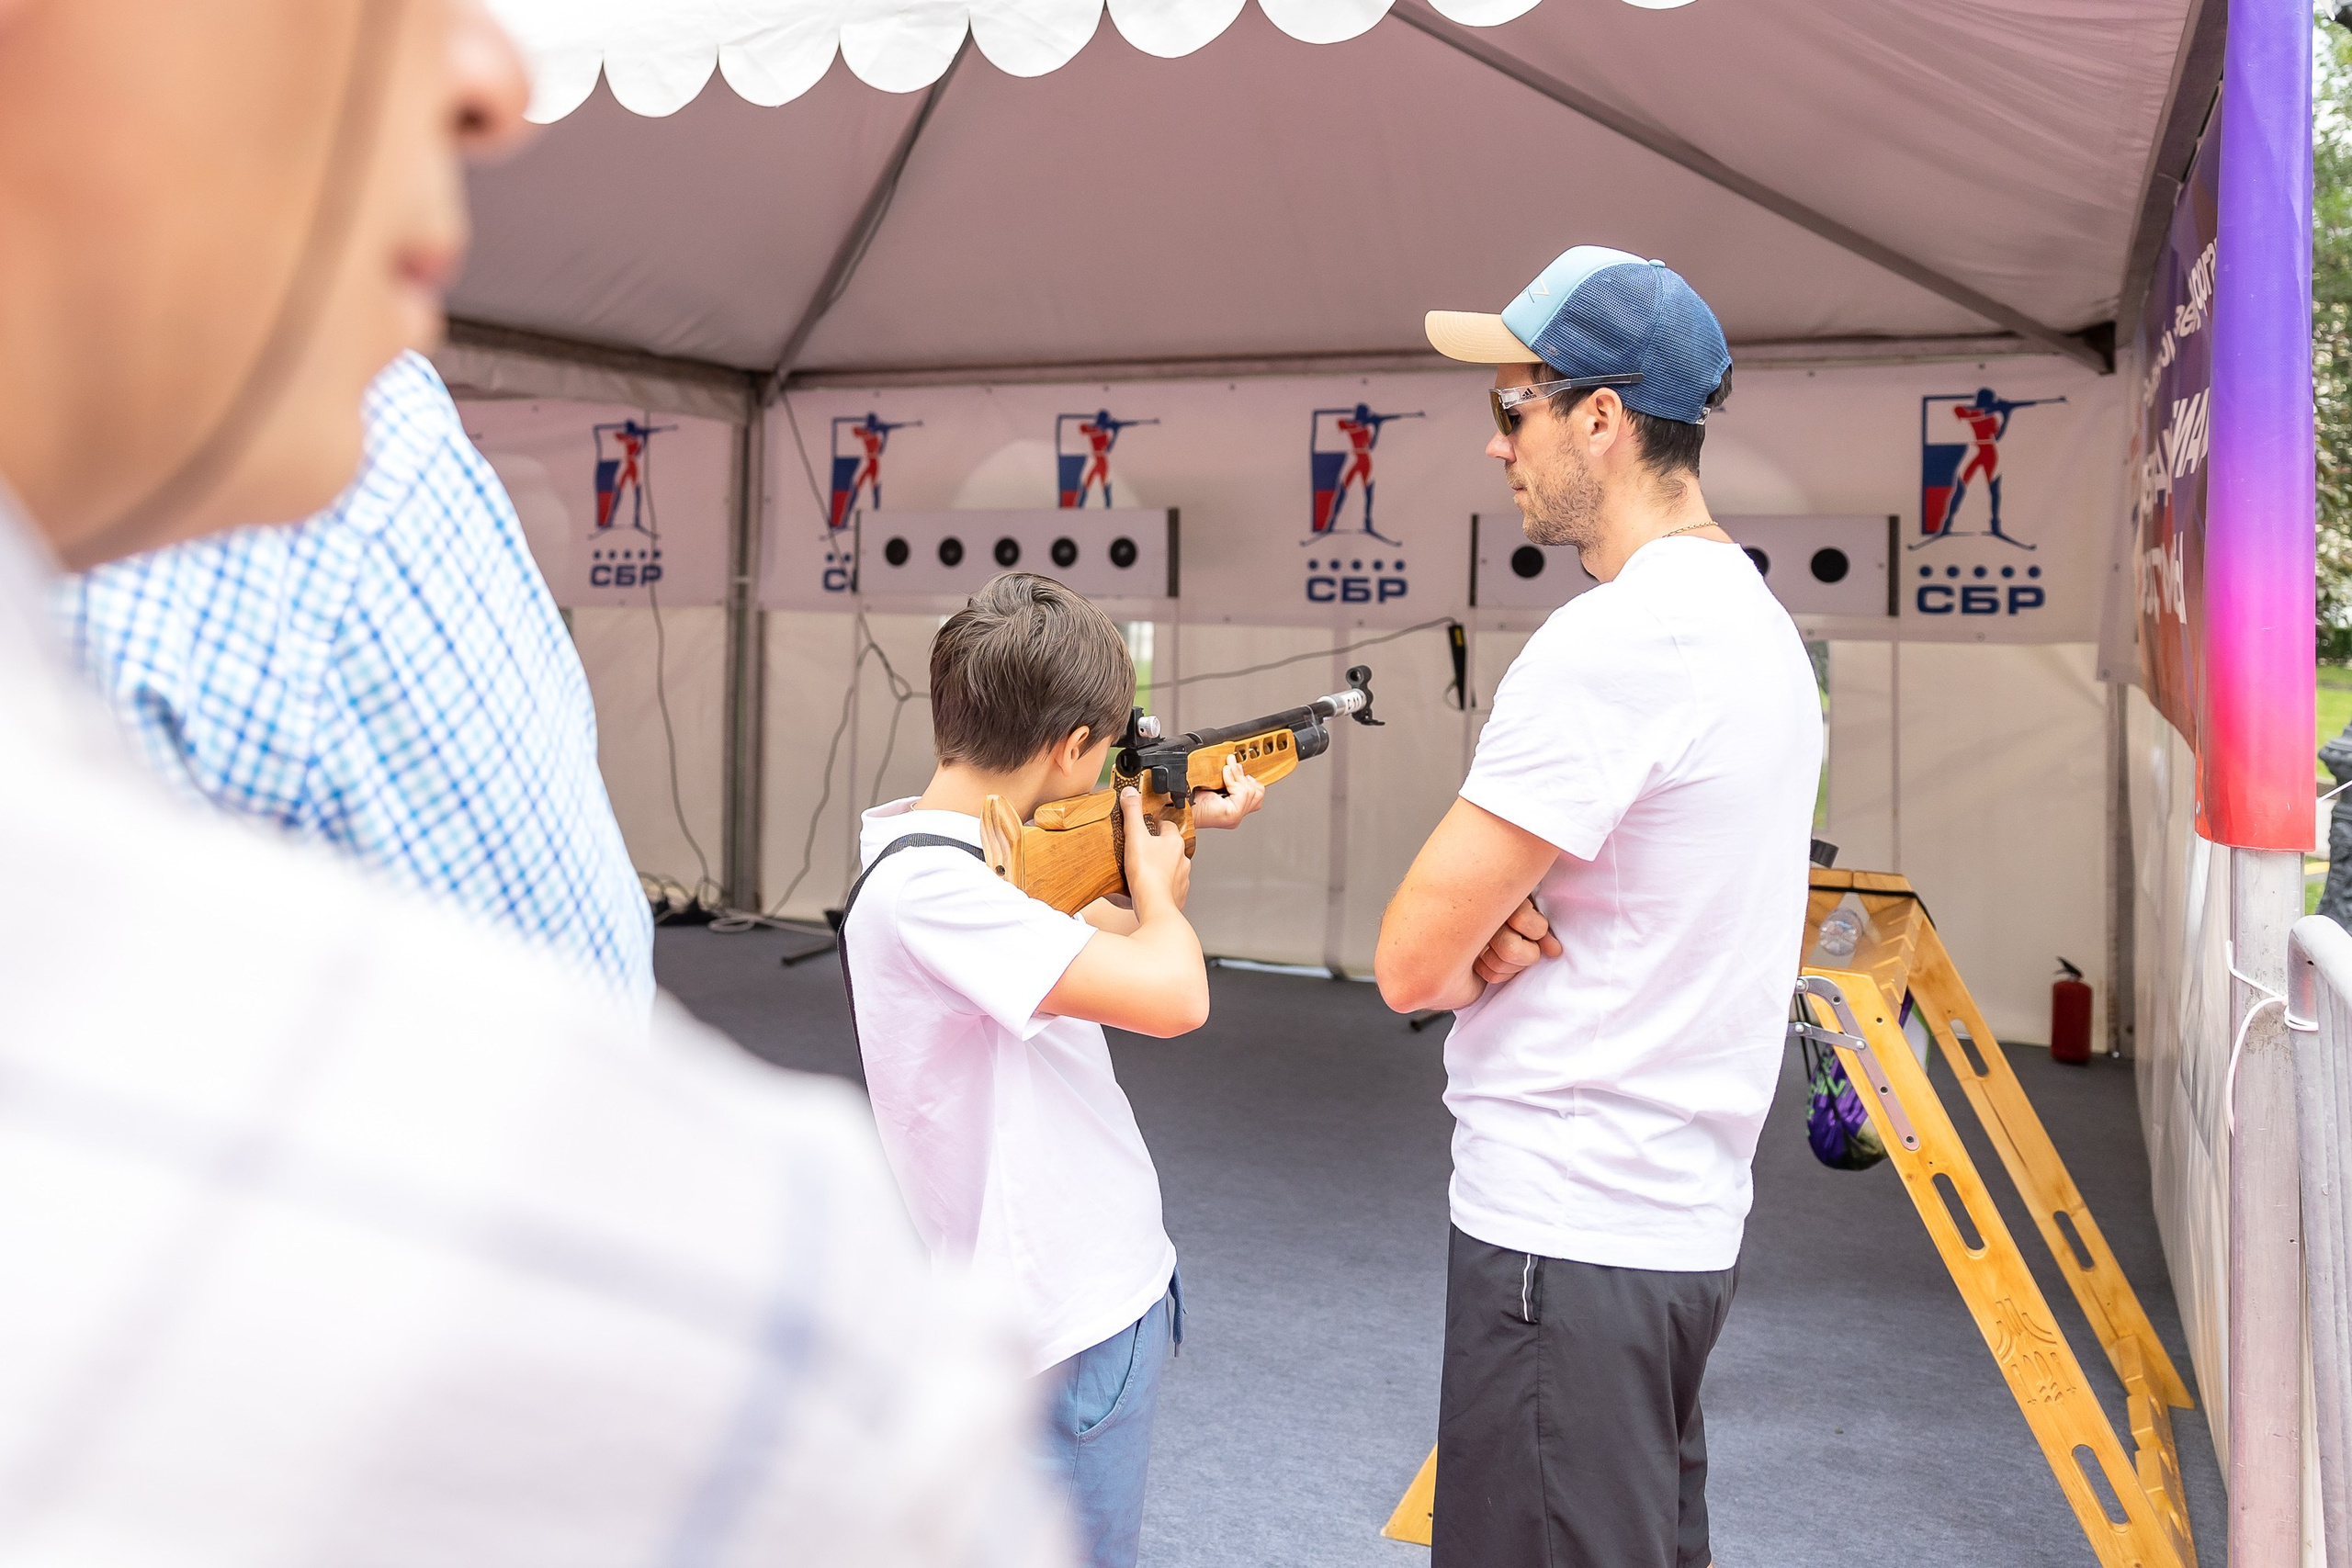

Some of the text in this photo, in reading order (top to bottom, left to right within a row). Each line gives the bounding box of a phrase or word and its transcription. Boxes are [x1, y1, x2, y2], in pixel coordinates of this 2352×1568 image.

[590, 564, 662, 586] СБР
[1306, 576, 1408, 604] СБР
[1916, 584, 2046, 615] СБР
